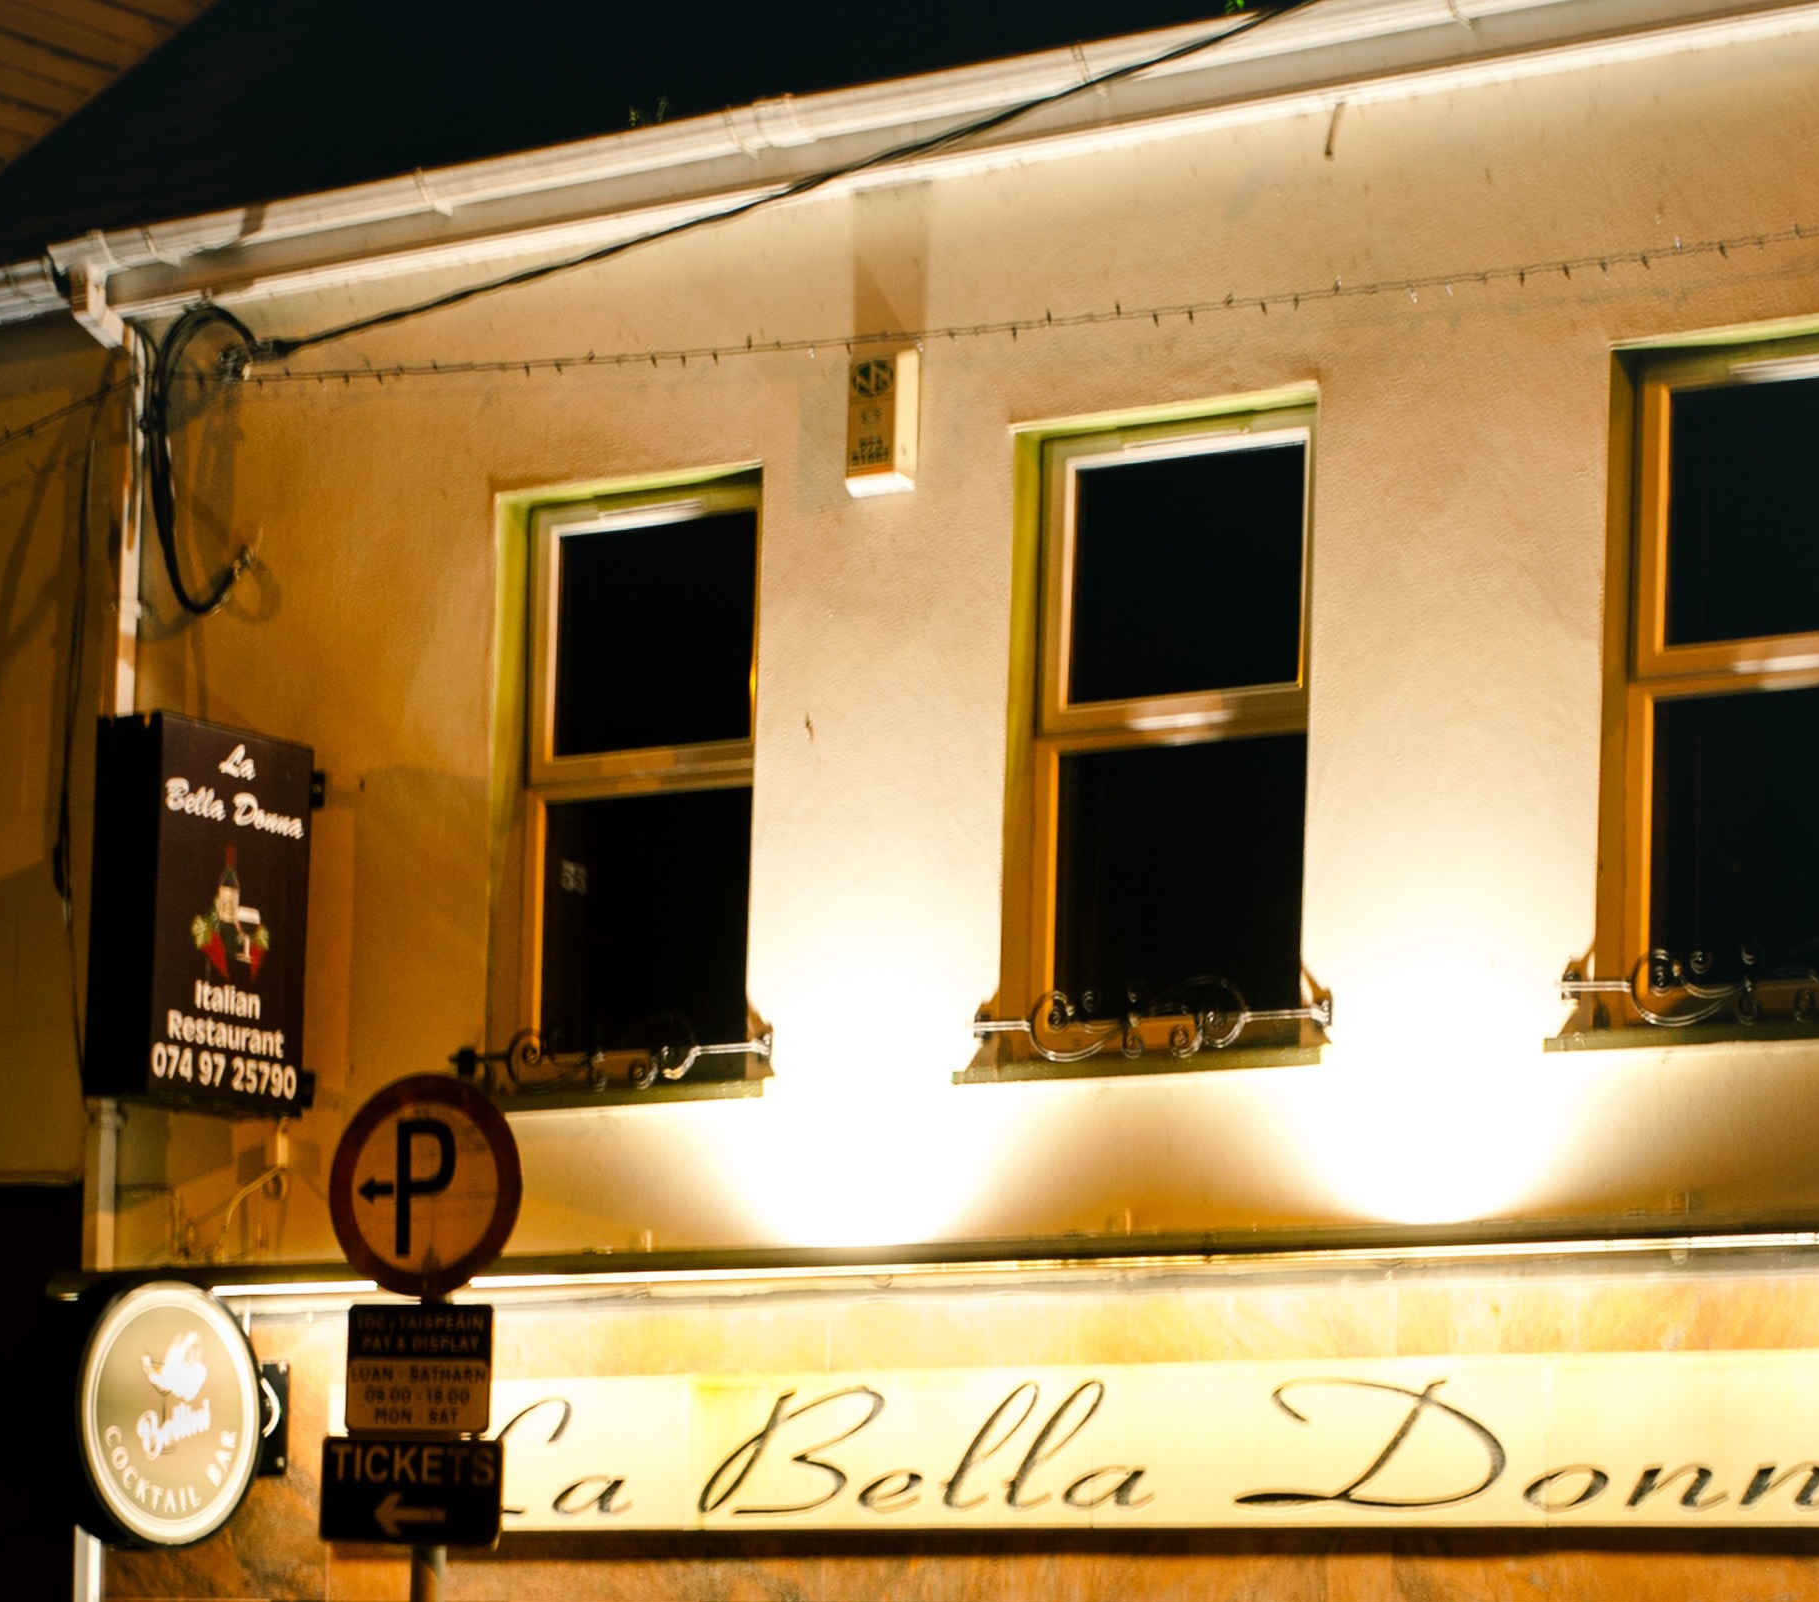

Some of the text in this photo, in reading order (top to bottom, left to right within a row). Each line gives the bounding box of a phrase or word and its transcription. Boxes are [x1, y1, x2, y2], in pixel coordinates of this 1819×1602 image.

[218, 743, 256, 781] La
[165, 777, 304, 840] Bella Donna
[194, 979, 261, 1020] Italian
[167, 1008, 285, 1059] Restaurant
[151, 1042, 297, 1101] 074 97 25790
[394, 1119, 457, 1257] P
[411, 1335, 480, 1353] DISPLAY
[375, 1407, 459, 1425] MON SAT
[103, 1424, 238, 1514] COCKTAIL BAR
[330, 1443, 495, 1486] TICKETS
[696, 1379, 1155, 1518] Bella
